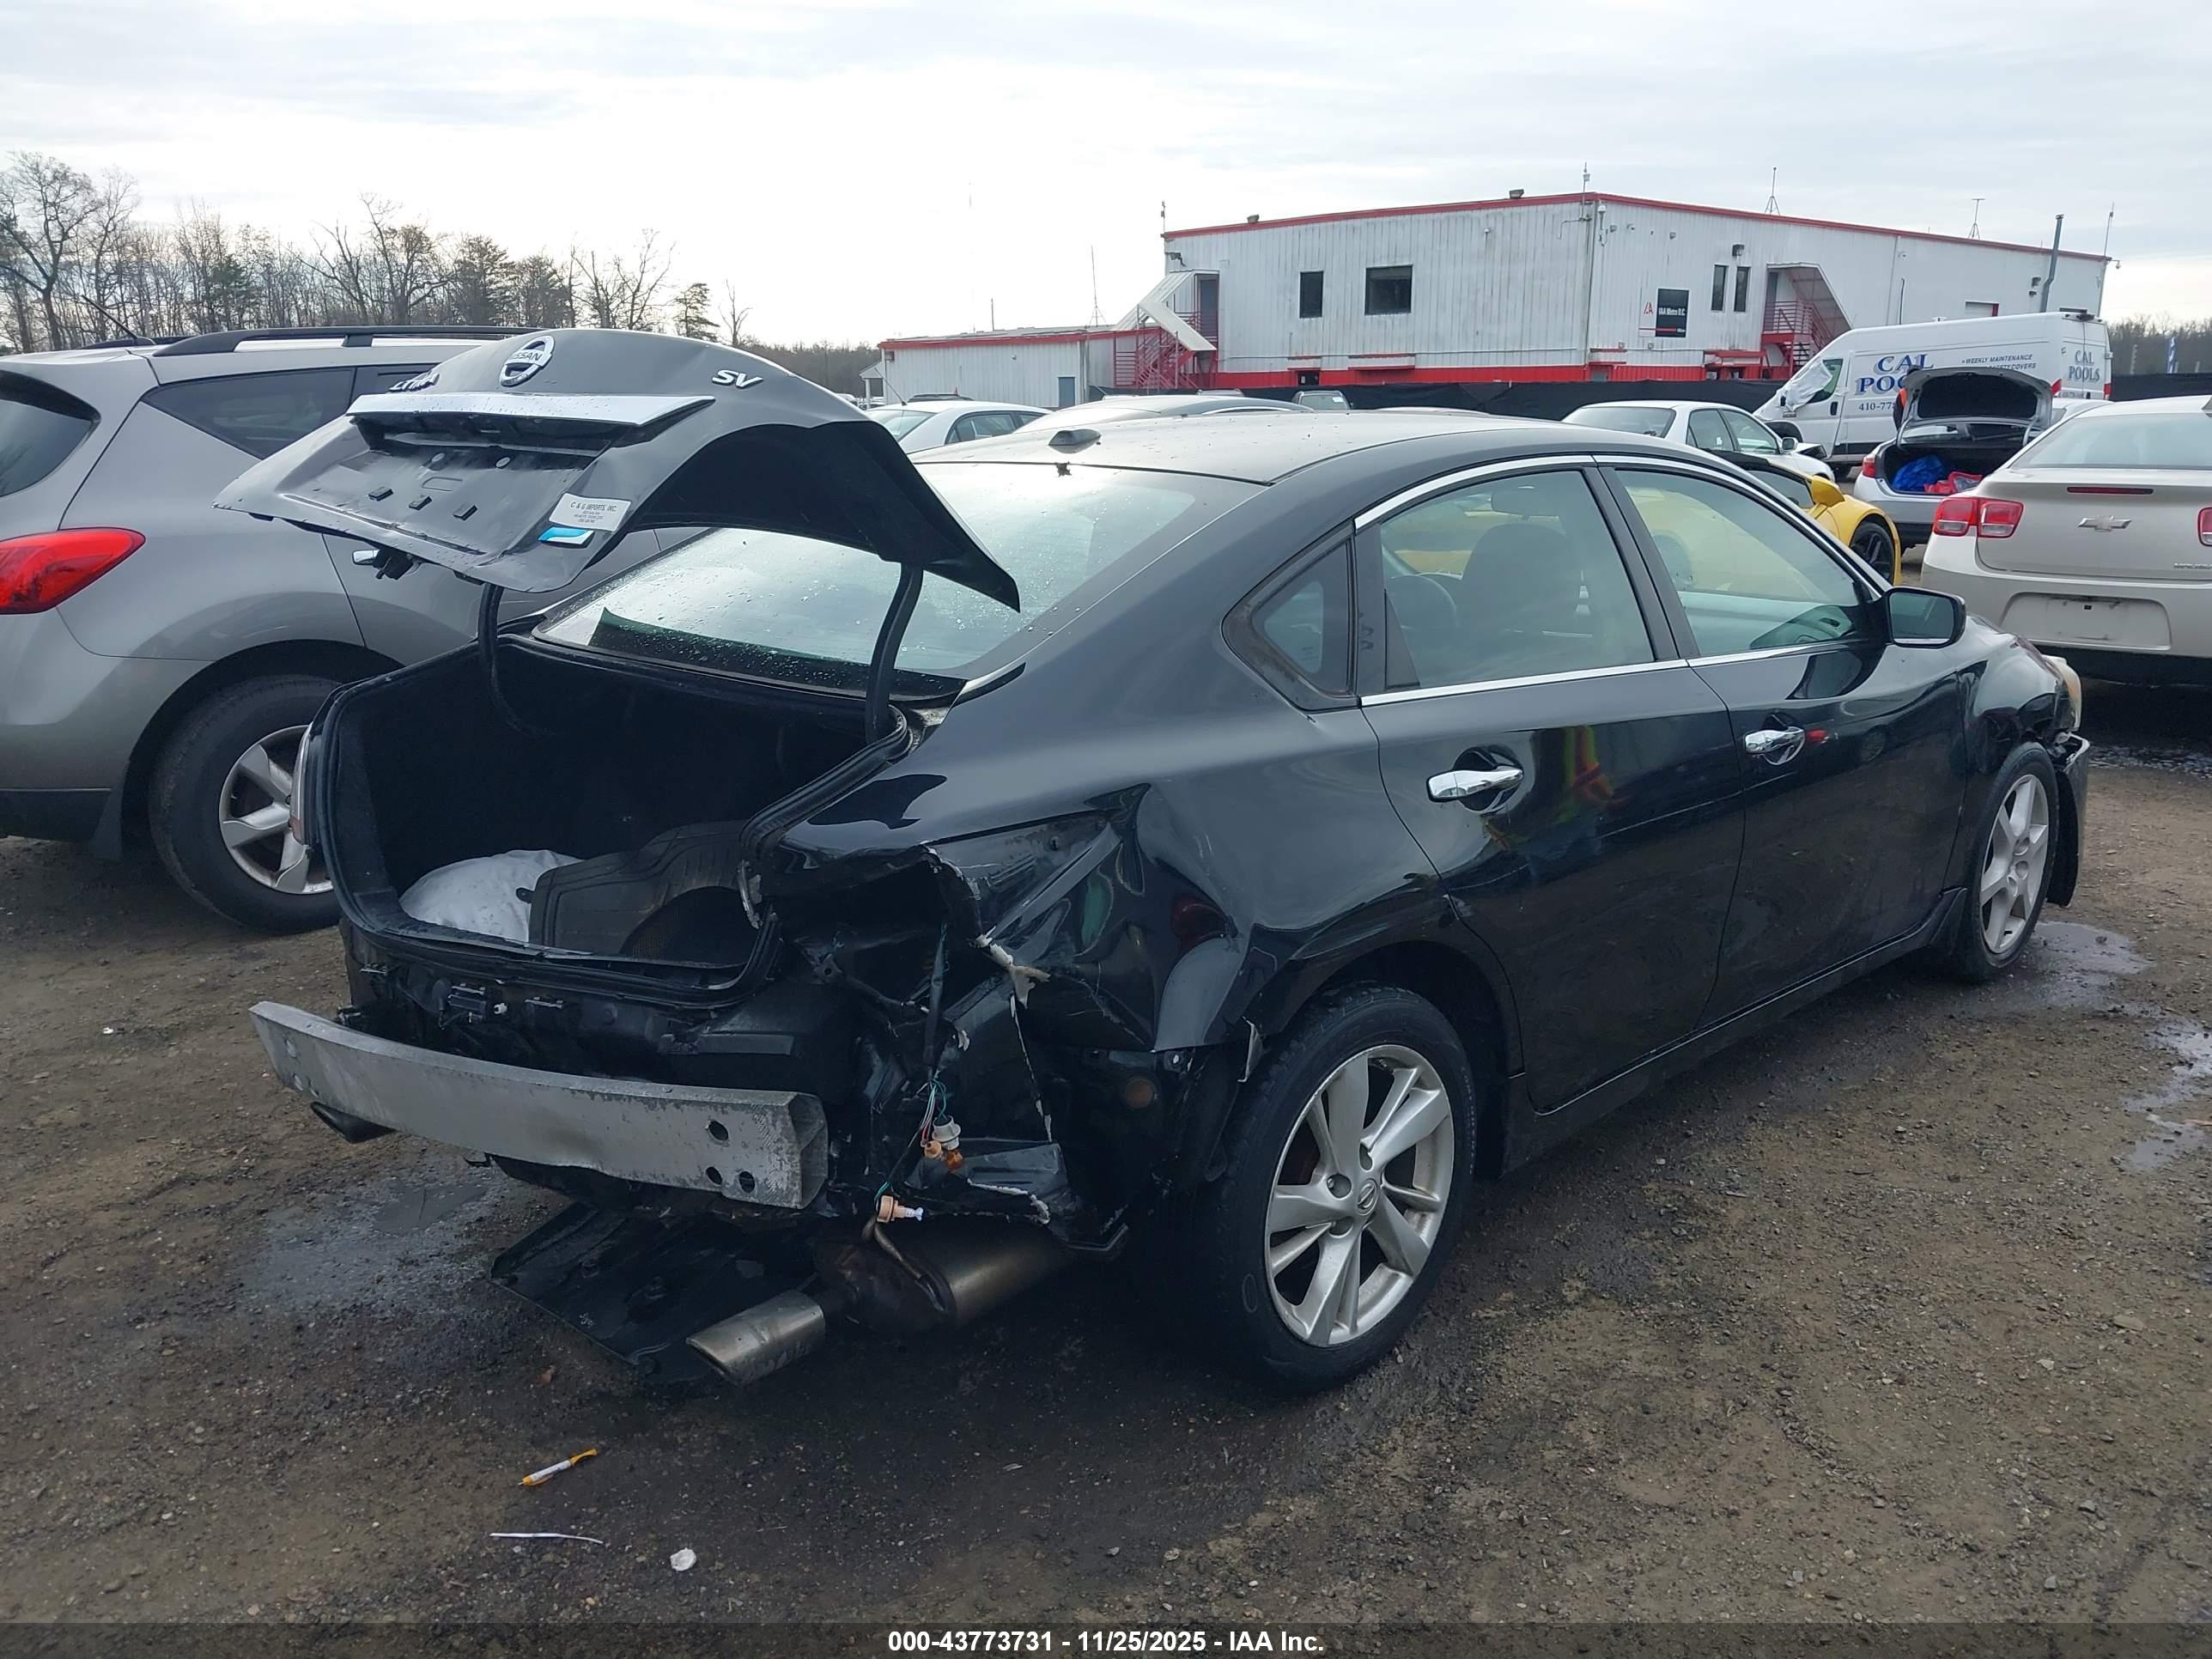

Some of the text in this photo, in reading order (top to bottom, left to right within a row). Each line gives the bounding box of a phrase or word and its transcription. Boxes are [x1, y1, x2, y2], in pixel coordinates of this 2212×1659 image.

[1875, 353, 1934, 374] CAL
[1990, 354, 2033, 362] MAINTENANCE
[2075, 350, 2095, 365] CAL
[712, 369, 763, 387] SV
[2069, 366, 2100, 382] POOLS
